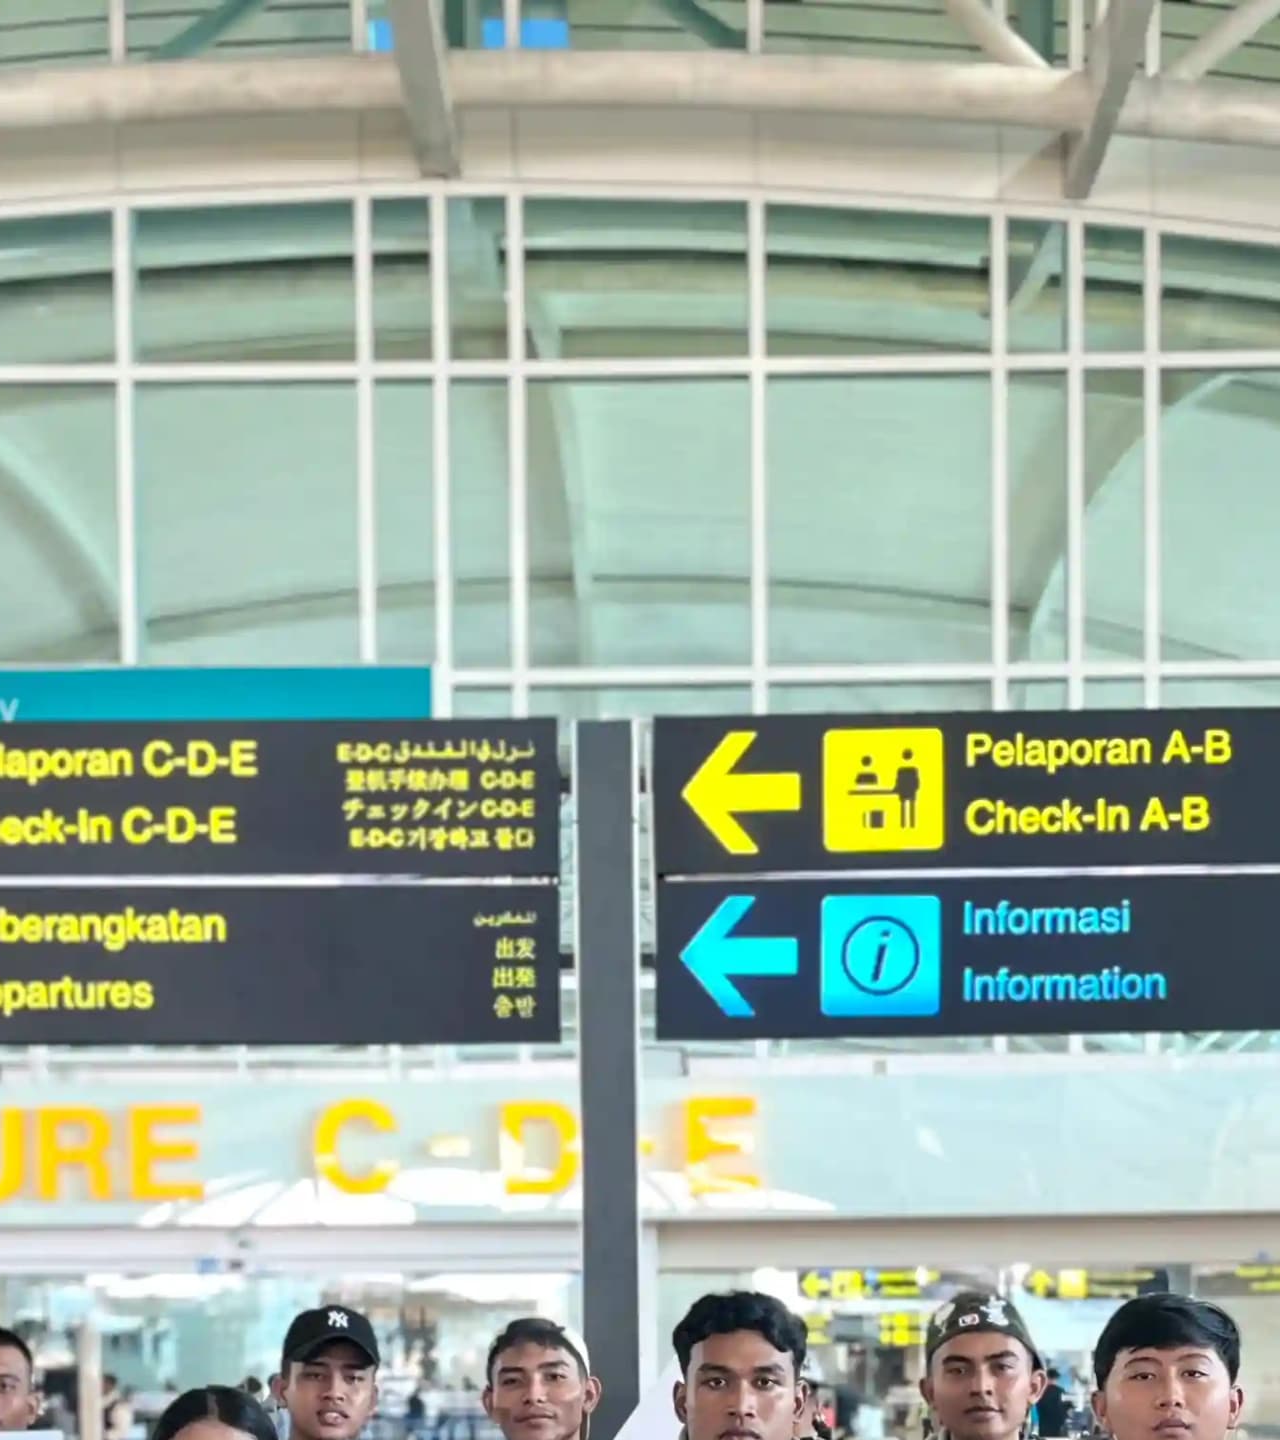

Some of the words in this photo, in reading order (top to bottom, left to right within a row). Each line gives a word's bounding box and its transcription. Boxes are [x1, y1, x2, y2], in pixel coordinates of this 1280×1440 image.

[142, 740, 258, 778] C-D-E
[966, 732, 1152, 774] Pelaporan
[1162, 729, 1232, 765] A-B
[122, 806, 238, 844] C-D-E
[965, 798, 1131, 836] Check-In
[1139, 796, 1210, 832] A-B
[963, 899, 1132, 935] Informasi
[963, 966, 1168, 1002] Information
